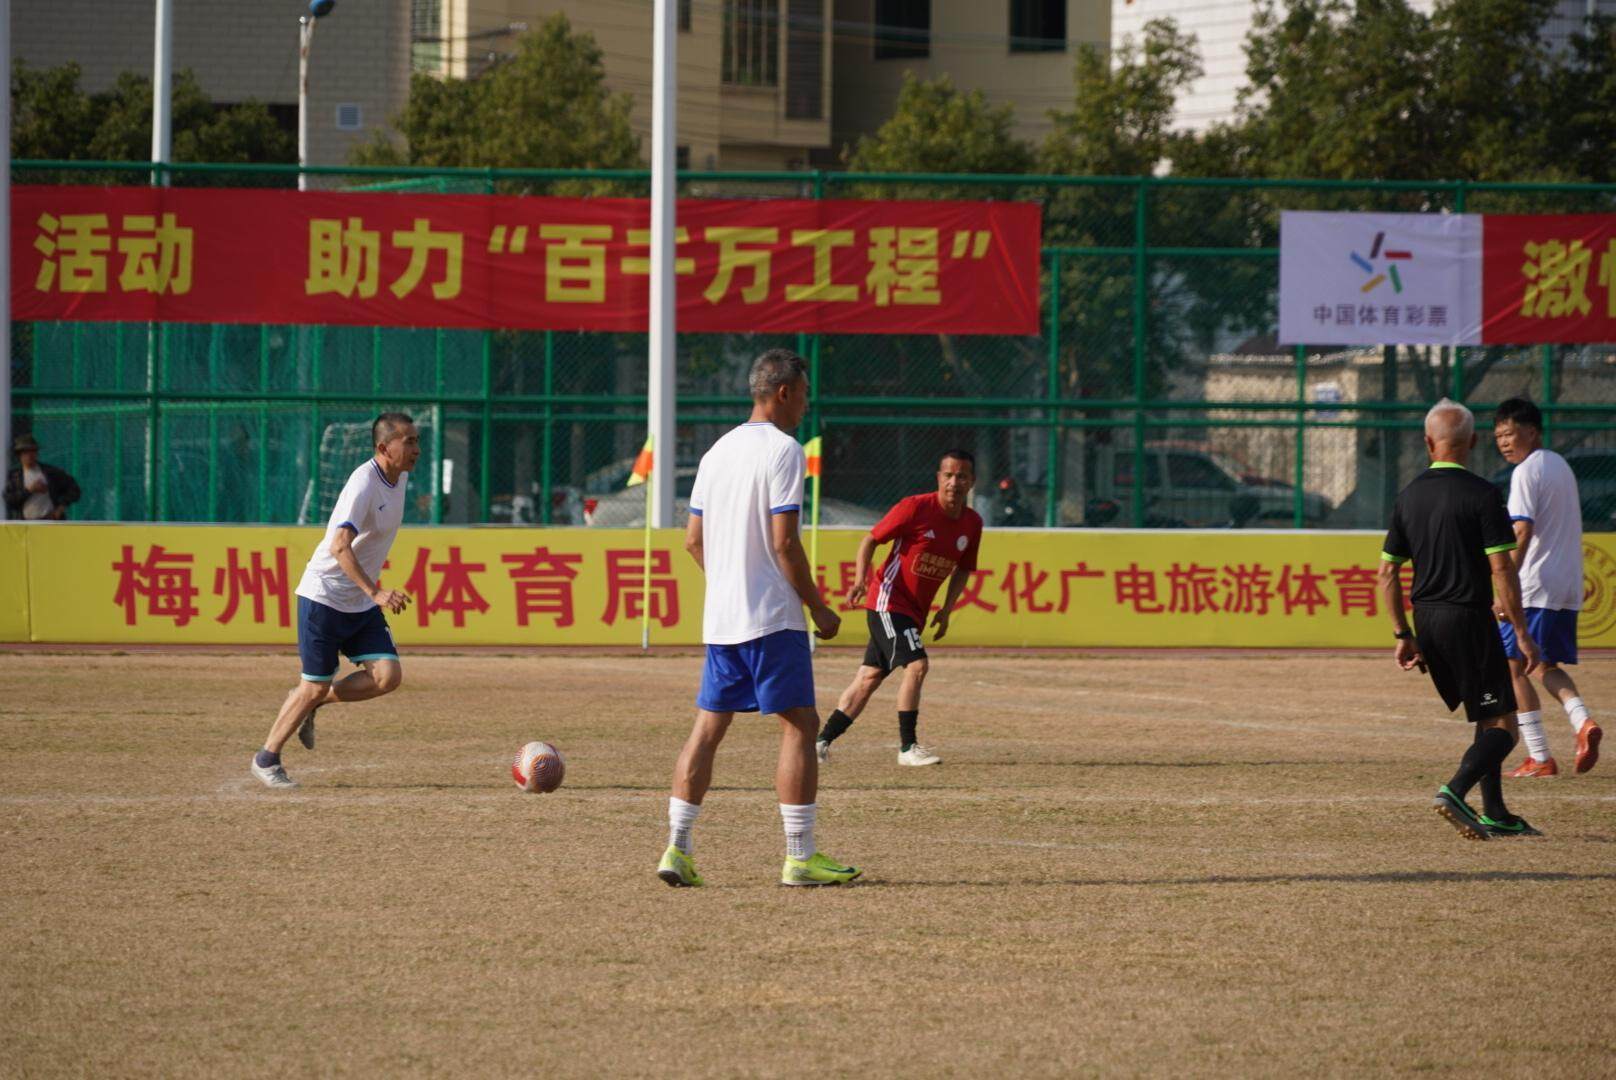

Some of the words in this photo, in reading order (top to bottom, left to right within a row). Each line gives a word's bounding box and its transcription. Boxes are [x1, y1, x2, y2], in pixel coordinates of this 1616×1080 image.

[34, 212, 195, 295] 活动
[1313, 303, 1448, 327] 中国体育彩票
[112, 545, 681, 628] 梅州体育局
[903, 627, 924, 651] 15
